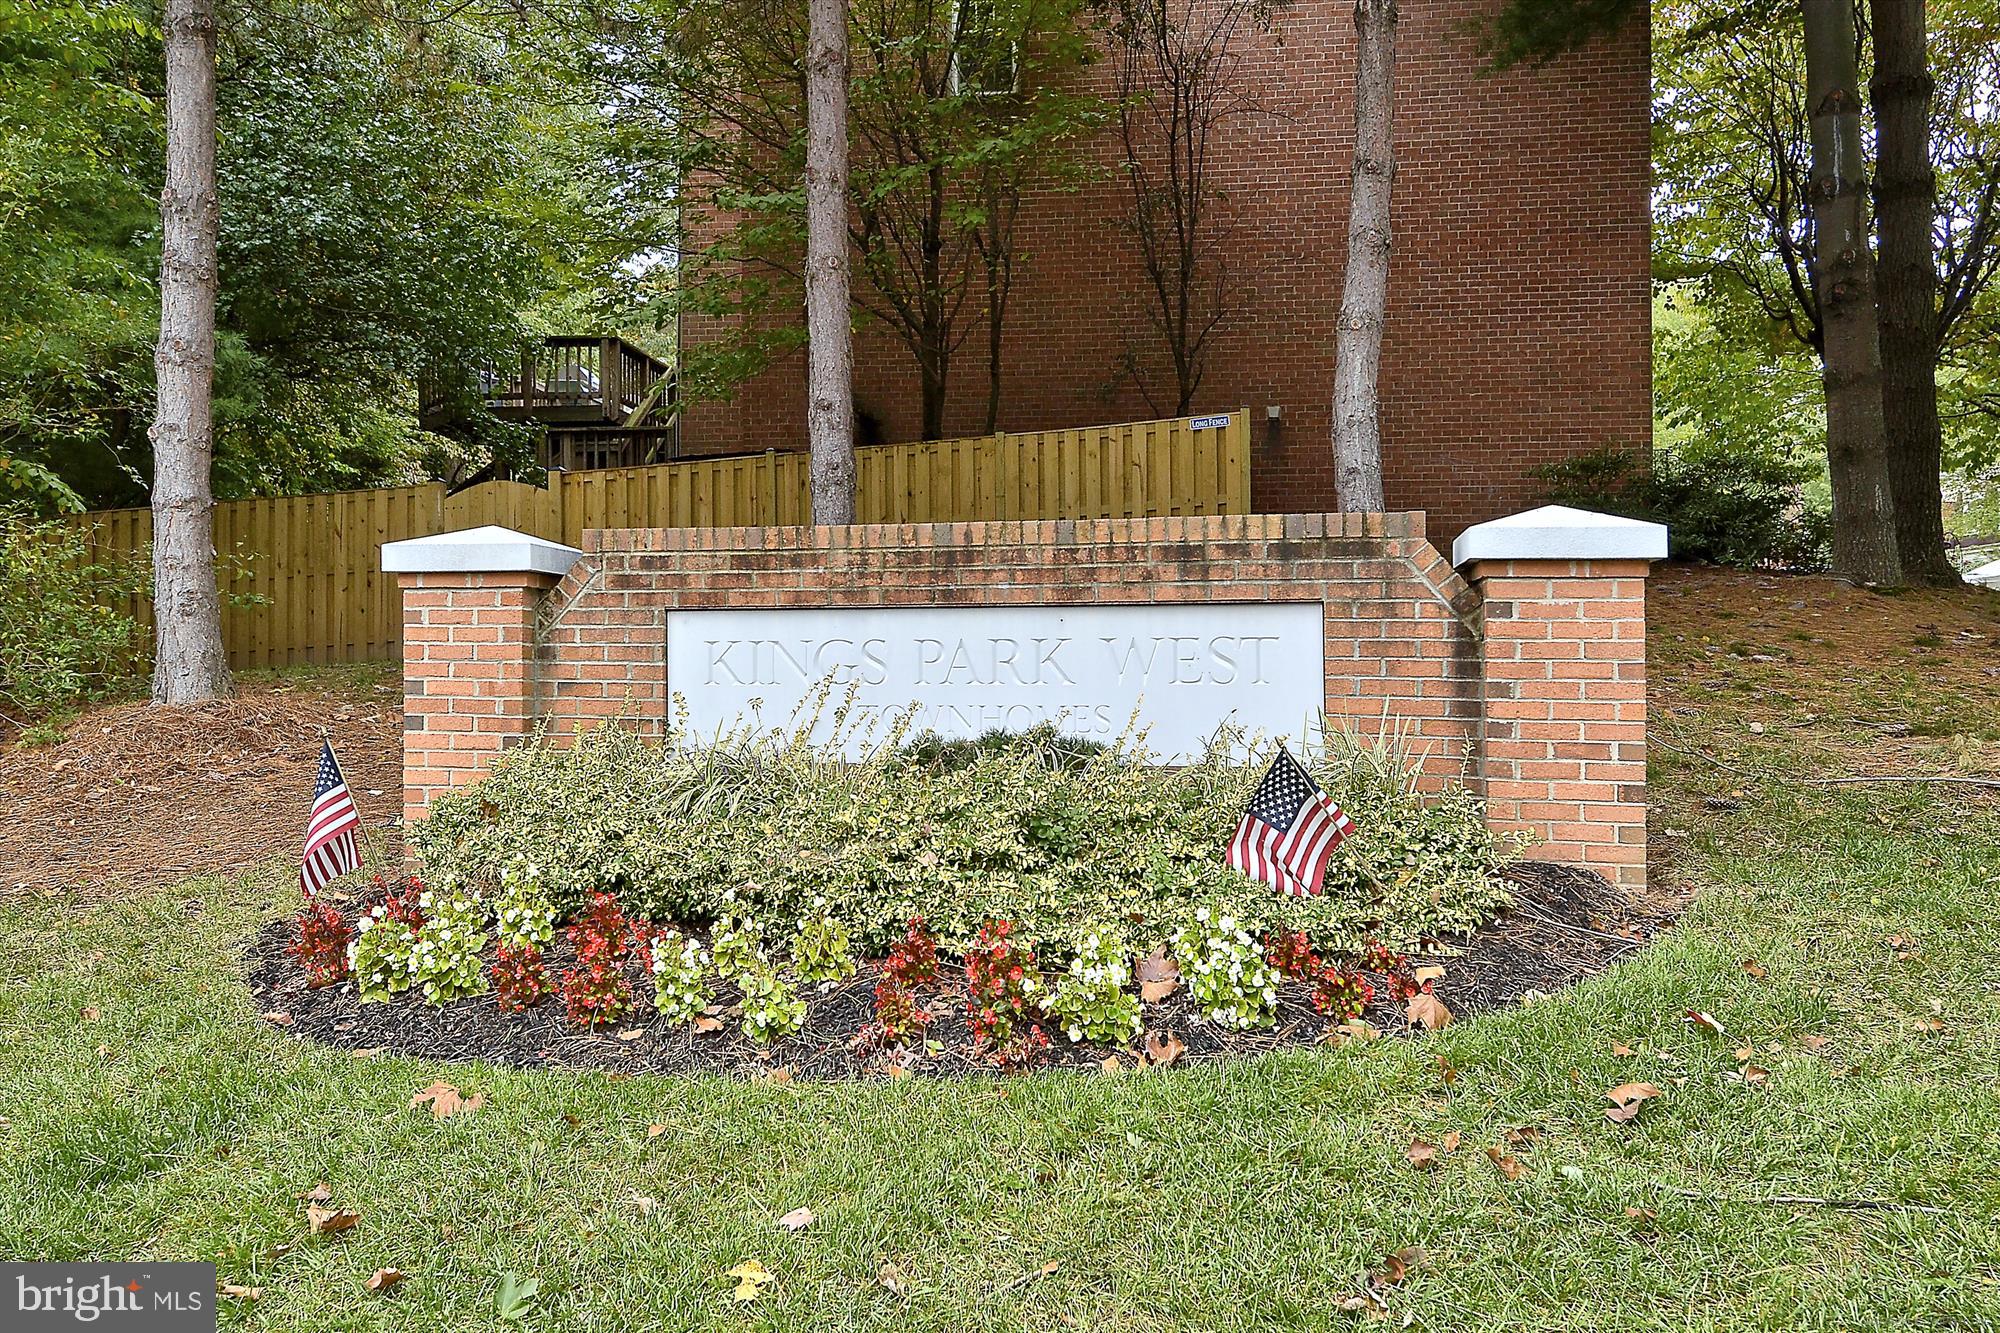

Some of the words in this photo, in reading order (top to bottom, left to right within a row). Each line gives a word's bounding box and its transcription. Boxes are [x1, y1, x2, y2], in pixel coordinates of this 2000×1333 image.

[1191, 419, 1208, 428] LONG
[1209, 417, 1228, 427] FENCE
[703, 638, 888, 686] KINGS
[912, 637, 1077, 685] PARK
[1099, 635, 1280, 686] WEST
[856, 703, 1112, 734] TOWNHOMES
